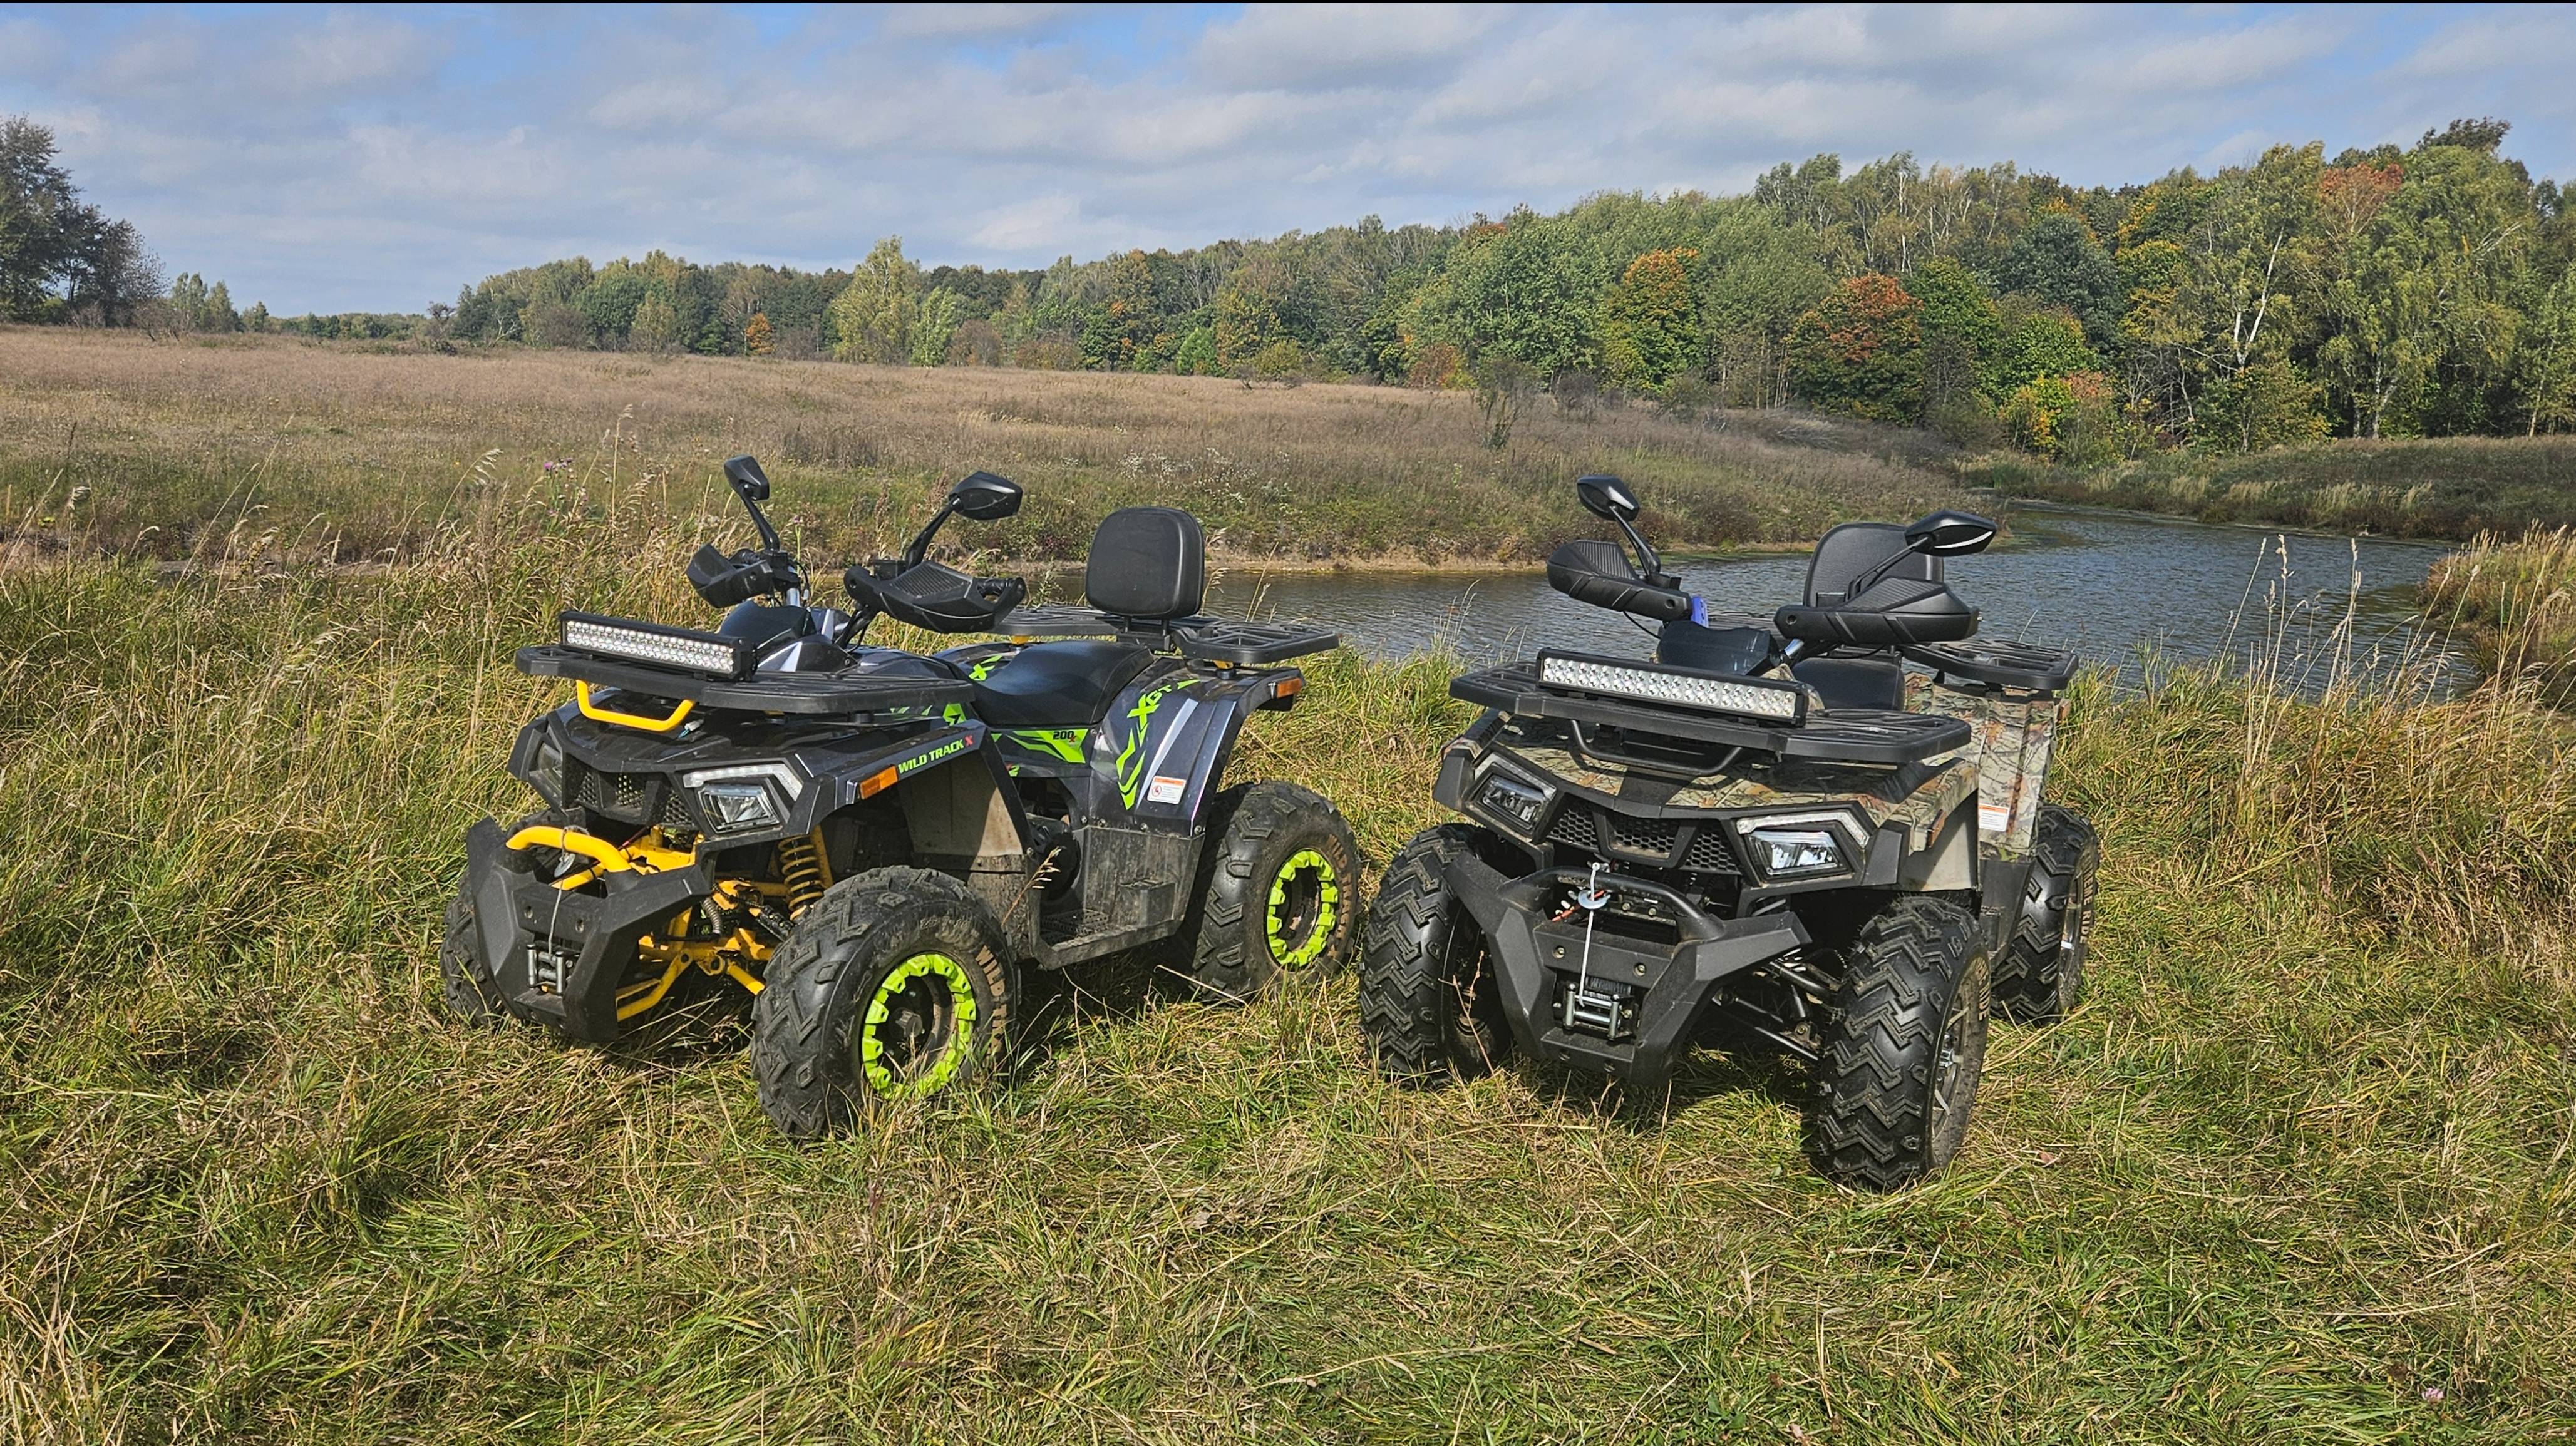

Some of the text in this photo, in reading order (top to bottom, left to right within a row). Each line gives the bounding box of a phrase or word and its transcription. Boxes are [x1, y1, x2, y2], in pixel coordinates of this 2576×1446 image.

[1053, 731, 1074, 740] 200
[898, 735, 973, 774] WILD TRACK X
[2079, 910, 2092, 944] RIDE
[976, 945, 1006, 997] WILD
